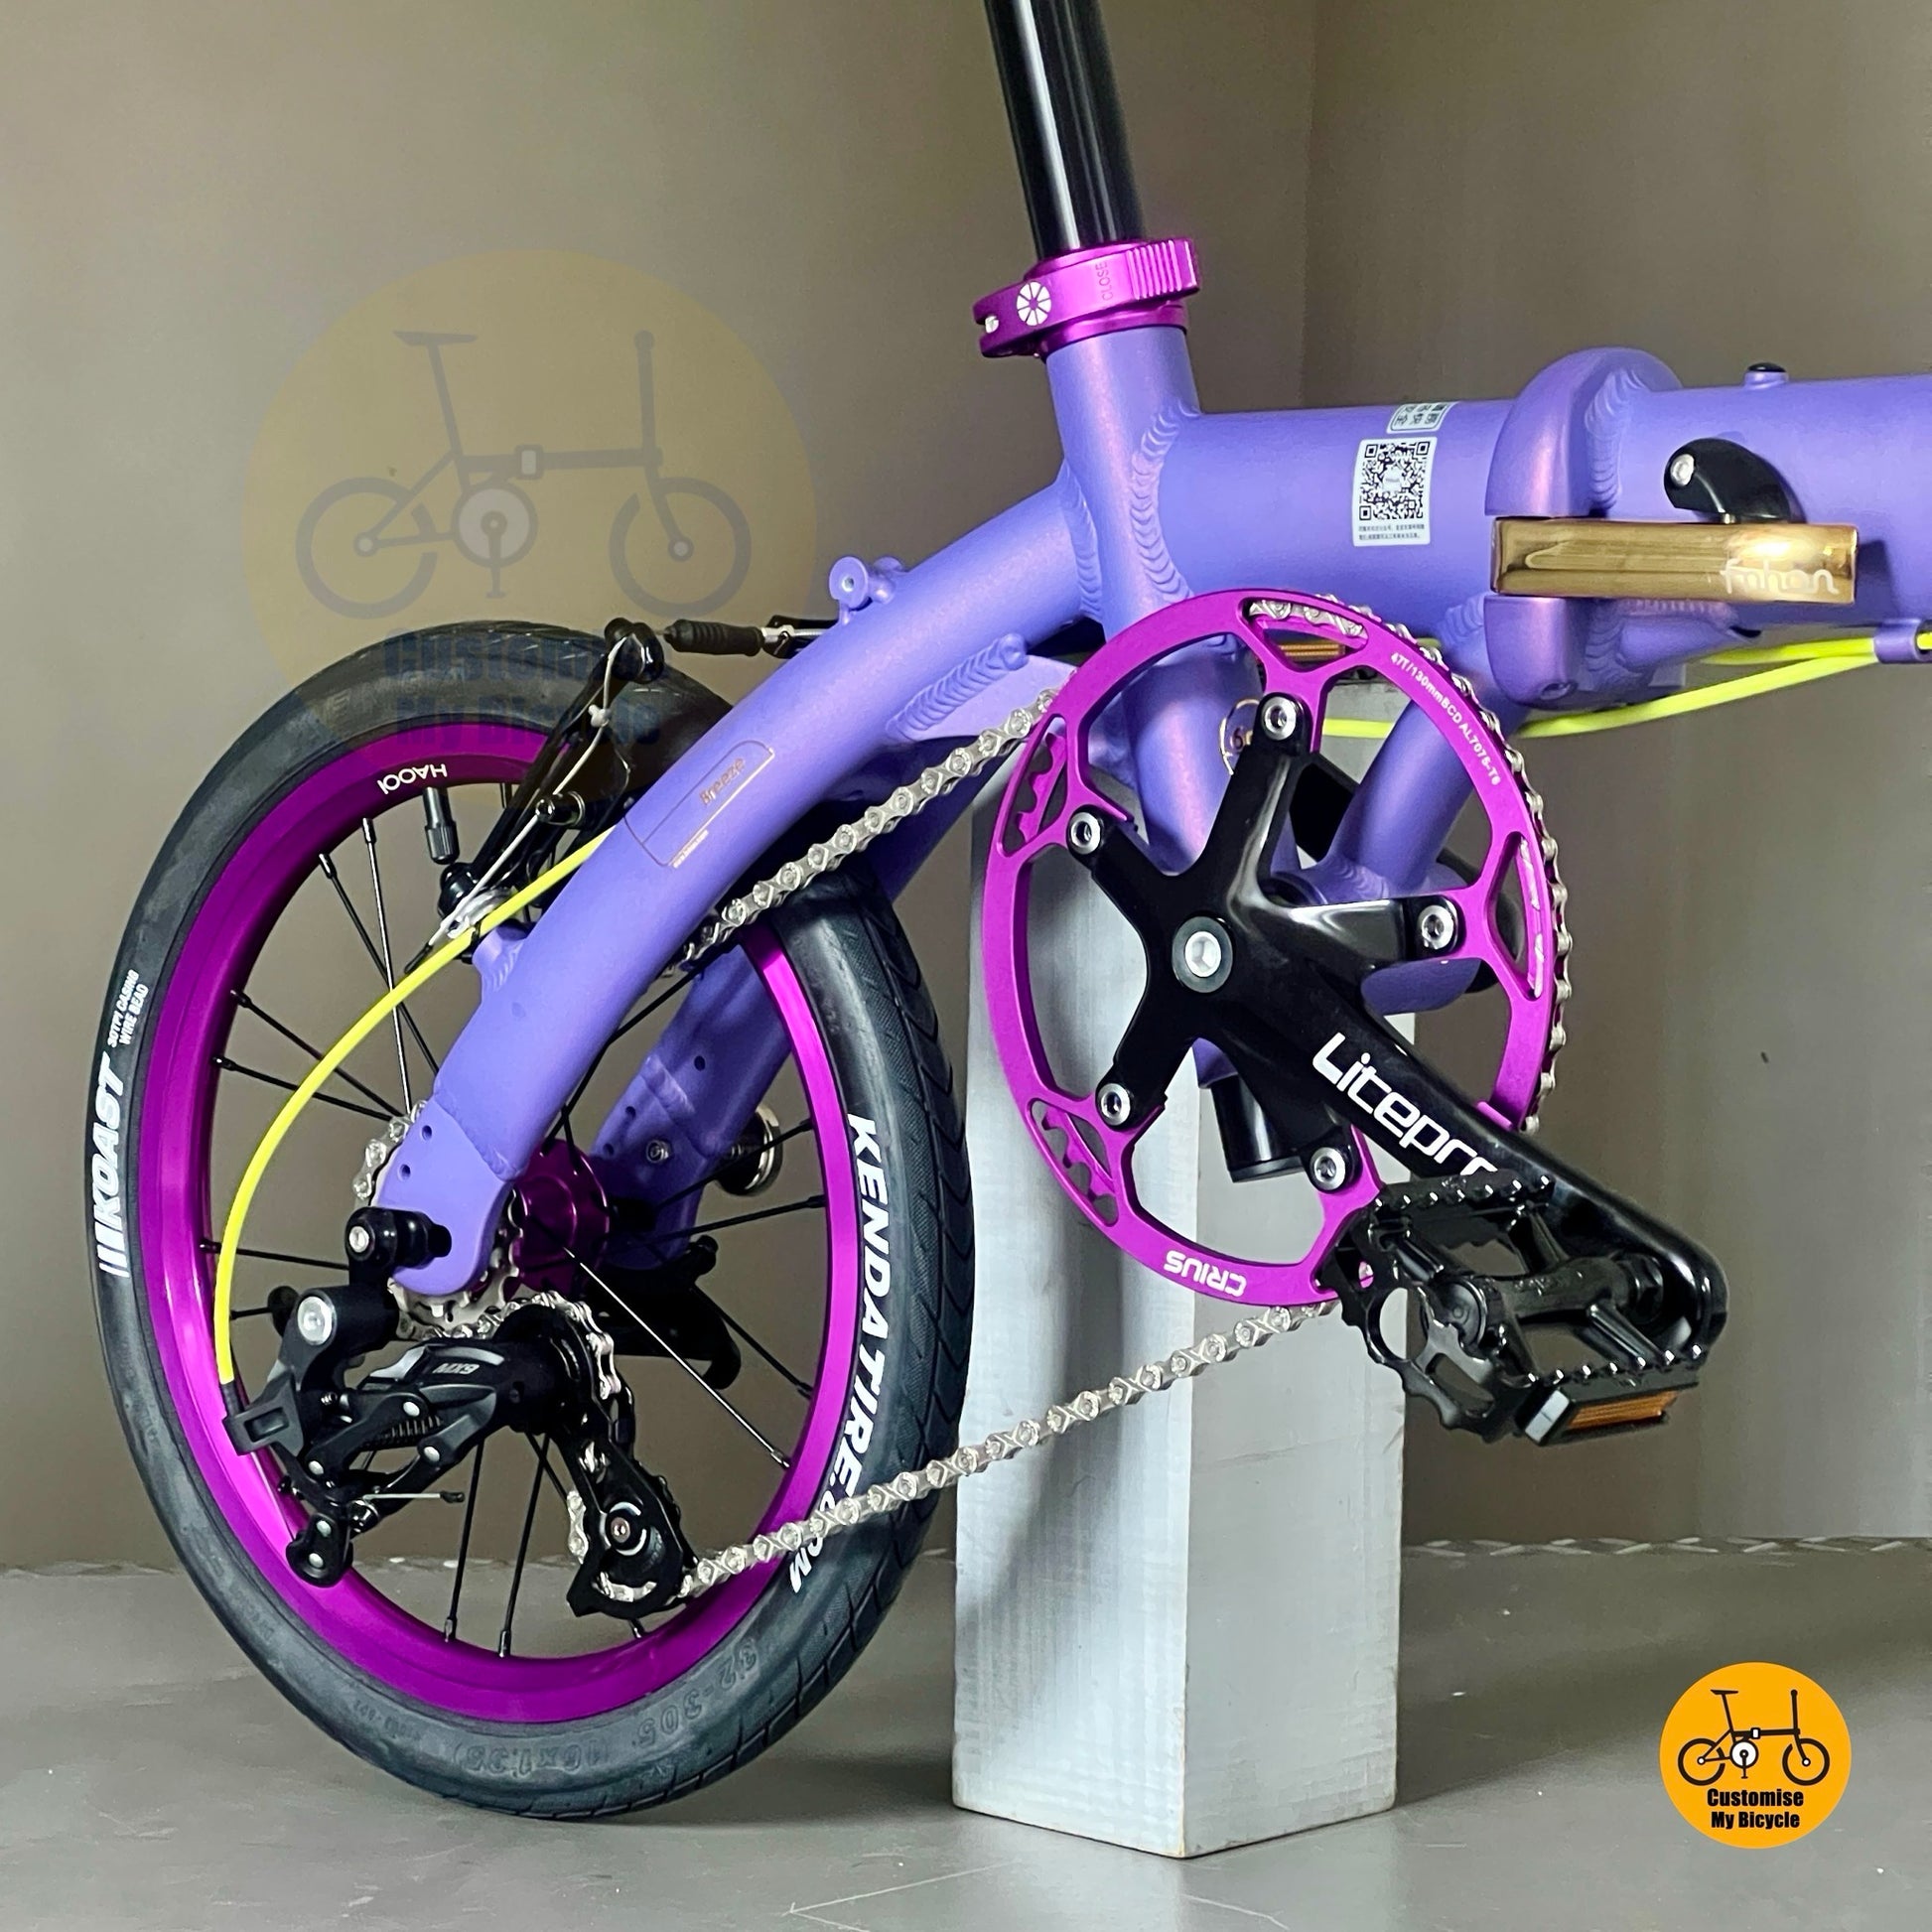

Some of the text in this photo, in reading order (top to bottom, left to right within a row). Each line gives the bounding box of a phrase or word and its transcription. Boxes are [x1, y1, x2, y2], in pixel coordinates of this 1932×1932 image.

[1095, 261, 1114, 302] CLOSE
[700, 758, 745, 805] Breeze
[116, 969, 139, 1013] CASING
[119, 983, 149, 1045] WIRE BEAD
[92, 1050, 124, 1230] KOAST
[1164, 1250, 1247, 1298] CRIUS
[432, 1362, 481, 1375] MX9
